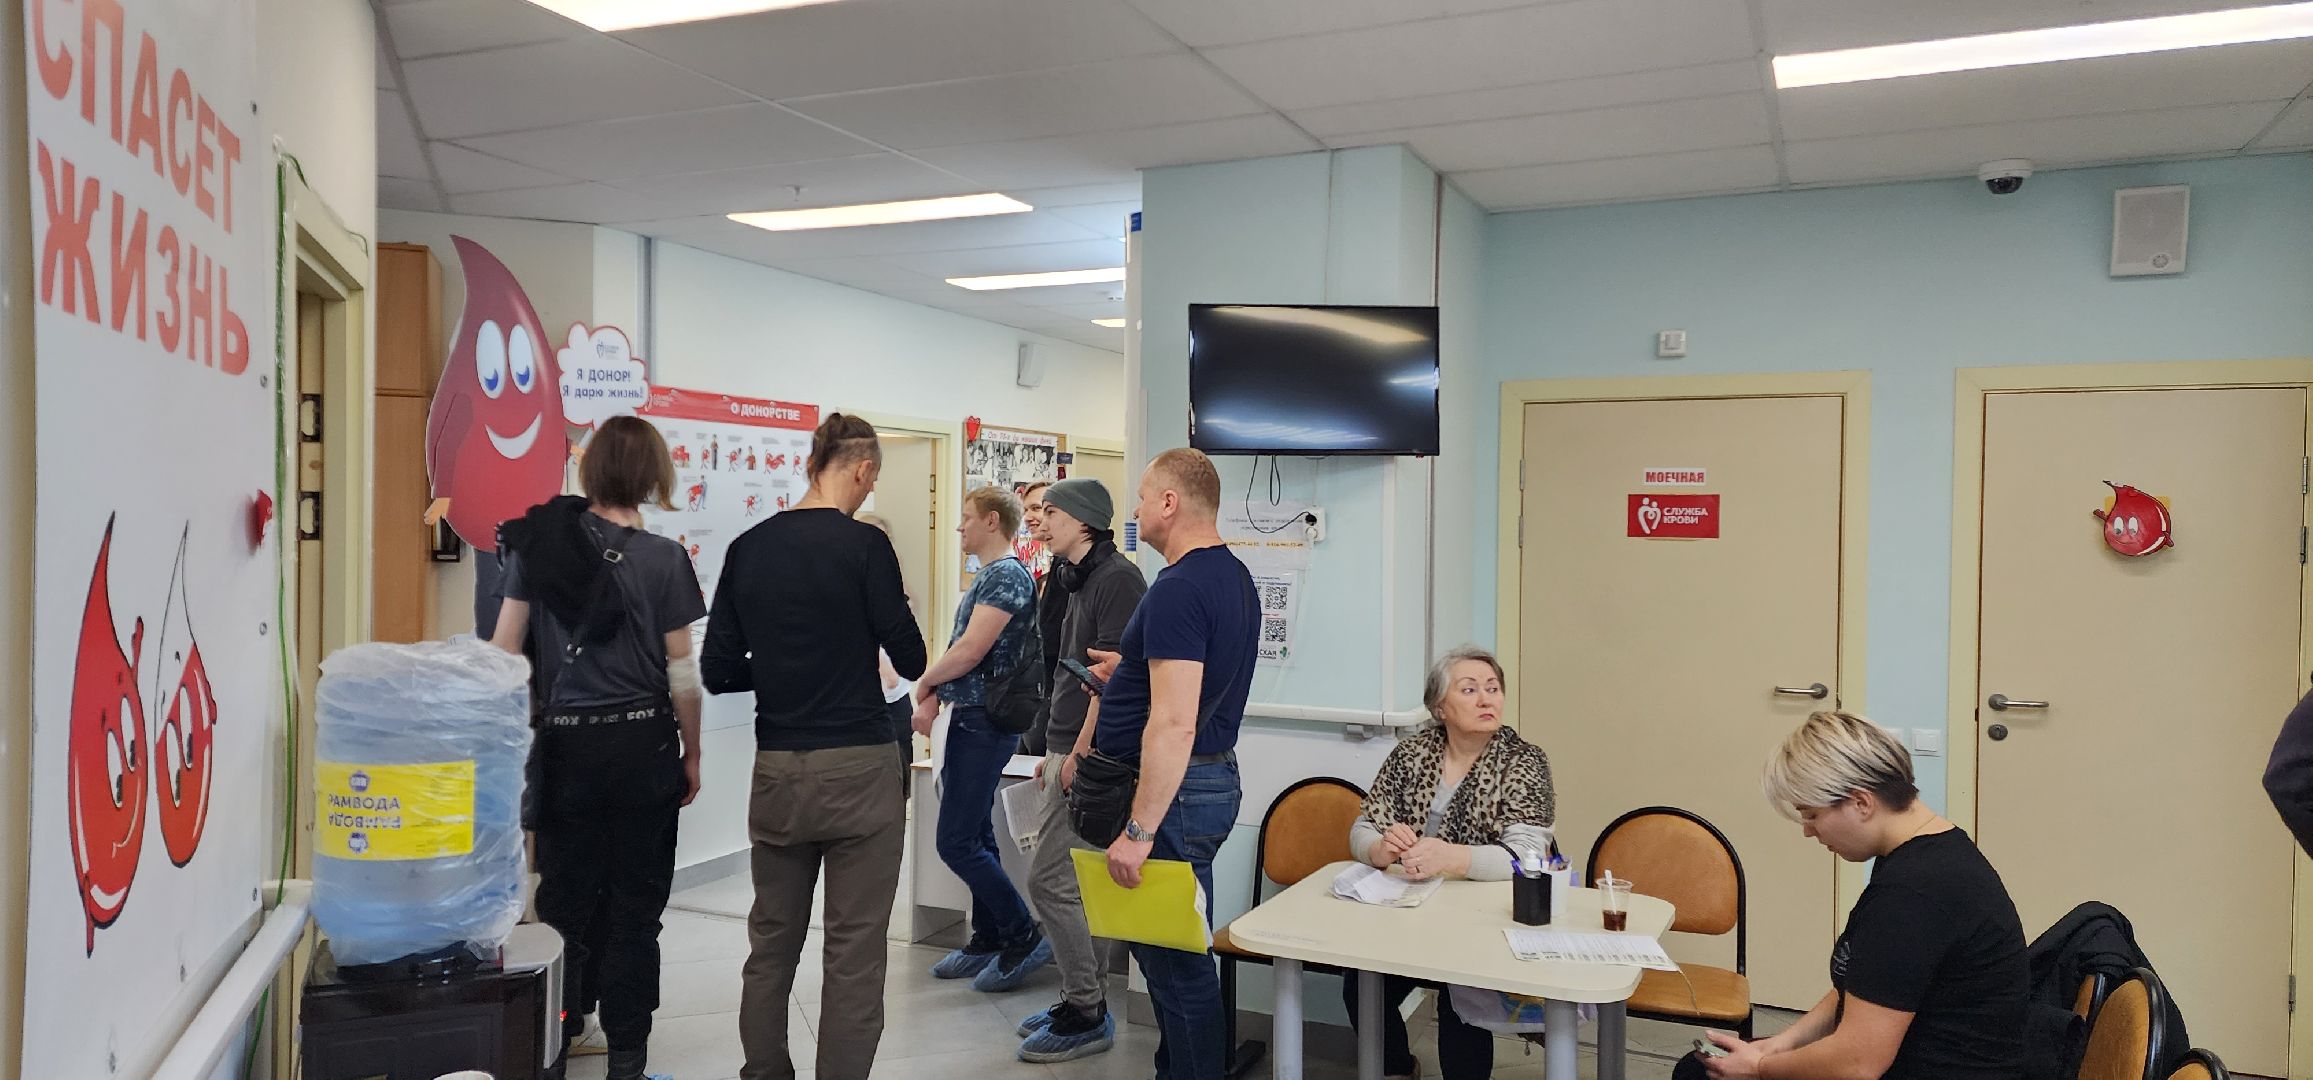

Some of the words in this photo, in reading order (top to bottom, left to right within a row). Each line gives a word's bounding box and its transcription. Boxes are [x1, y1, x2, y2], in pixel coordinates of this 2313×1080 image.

[33, 0, 241, 234] СПАСЕТ
[37, 138, 249, 376] ЖИЗНЬ
[576, 368, 583, 380] Я
[588, 369, 631, 383] ДОНОР!
[562, 385, 569, 397] Я
[574, 388, 604, 400] дарю
[730, 402, 739, 414] О
[740, 403, 801, 421] ДОНОРСТВЕ
[1645, 471, 1705, 483] МОЕЧНАЯ
[1663, 507, 1709, 516] СЛУЖБА
[1663, 516, 1699, 525] КРОВИ
[554, 715, 579, 726] FOX
[626, 708, 656, 721] FOX
